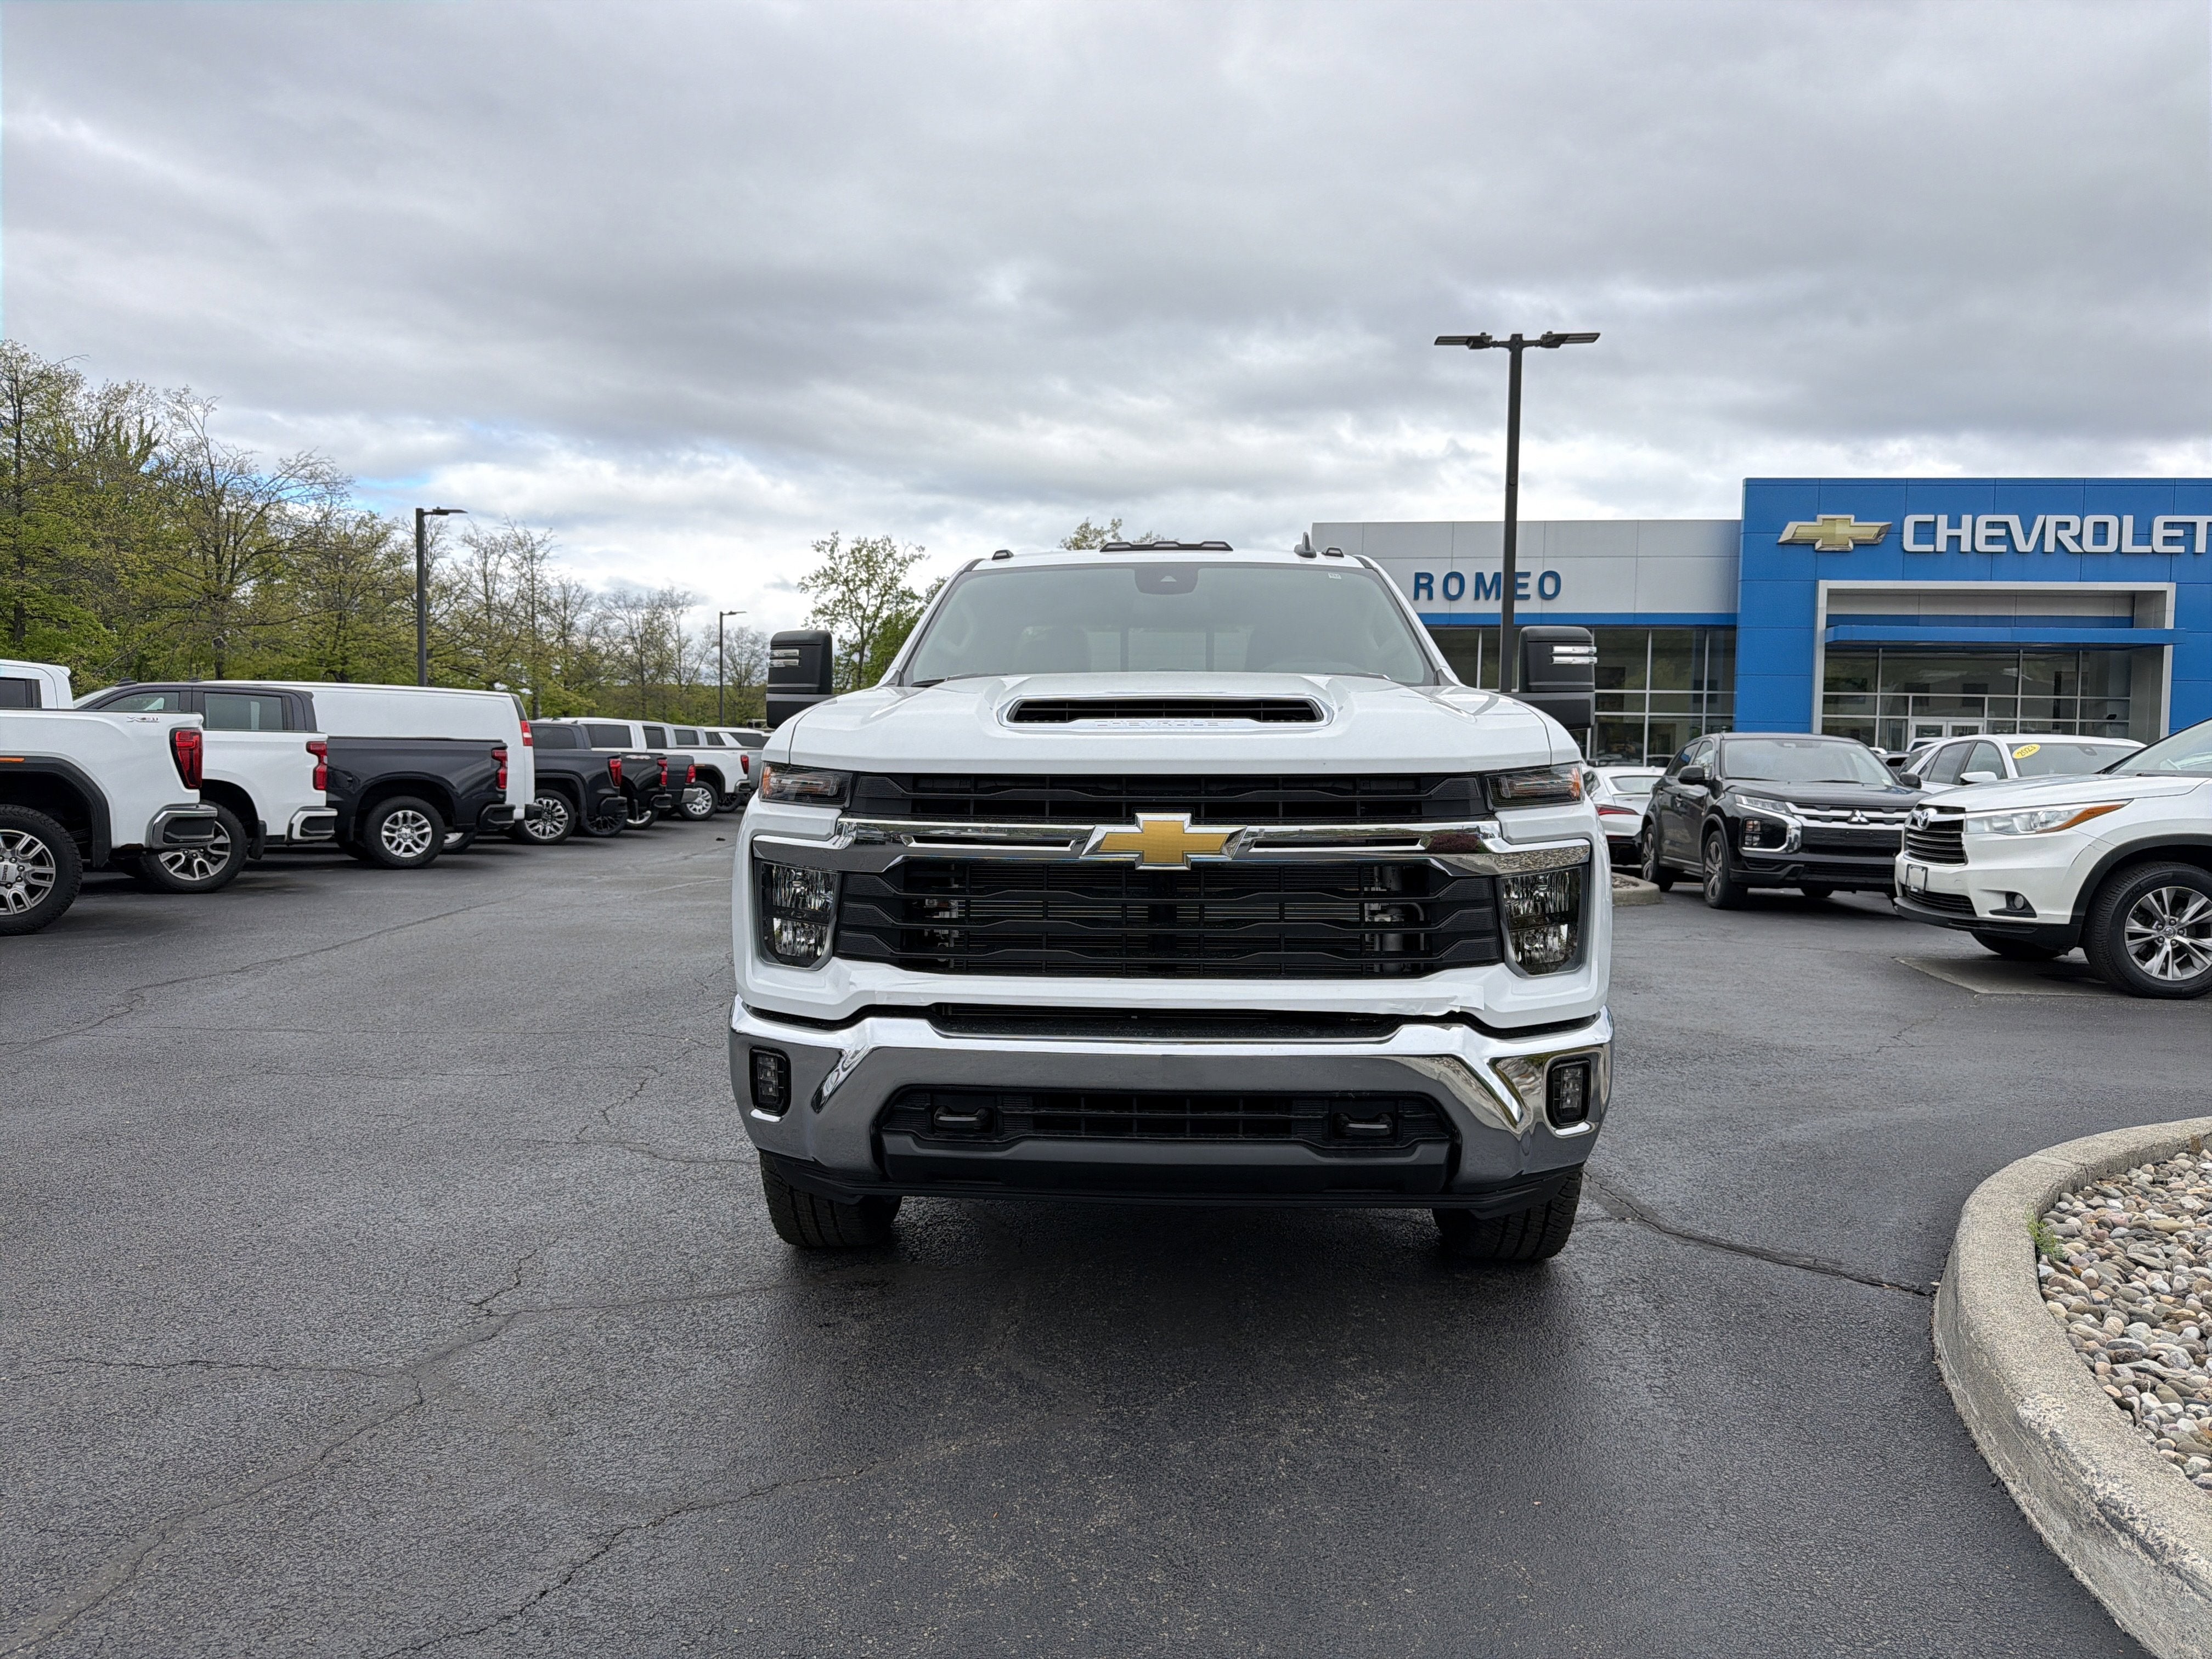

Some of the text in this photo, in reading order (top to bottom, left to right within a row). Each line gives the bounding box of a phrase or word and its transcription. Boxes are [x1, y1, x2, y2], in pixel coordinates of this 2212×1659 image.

[1903, 515, 2212, 553] CHEVROLET
[1413, 571, 1561, 601] ROMEO
[2017, 745, 2036, 757] 2023
